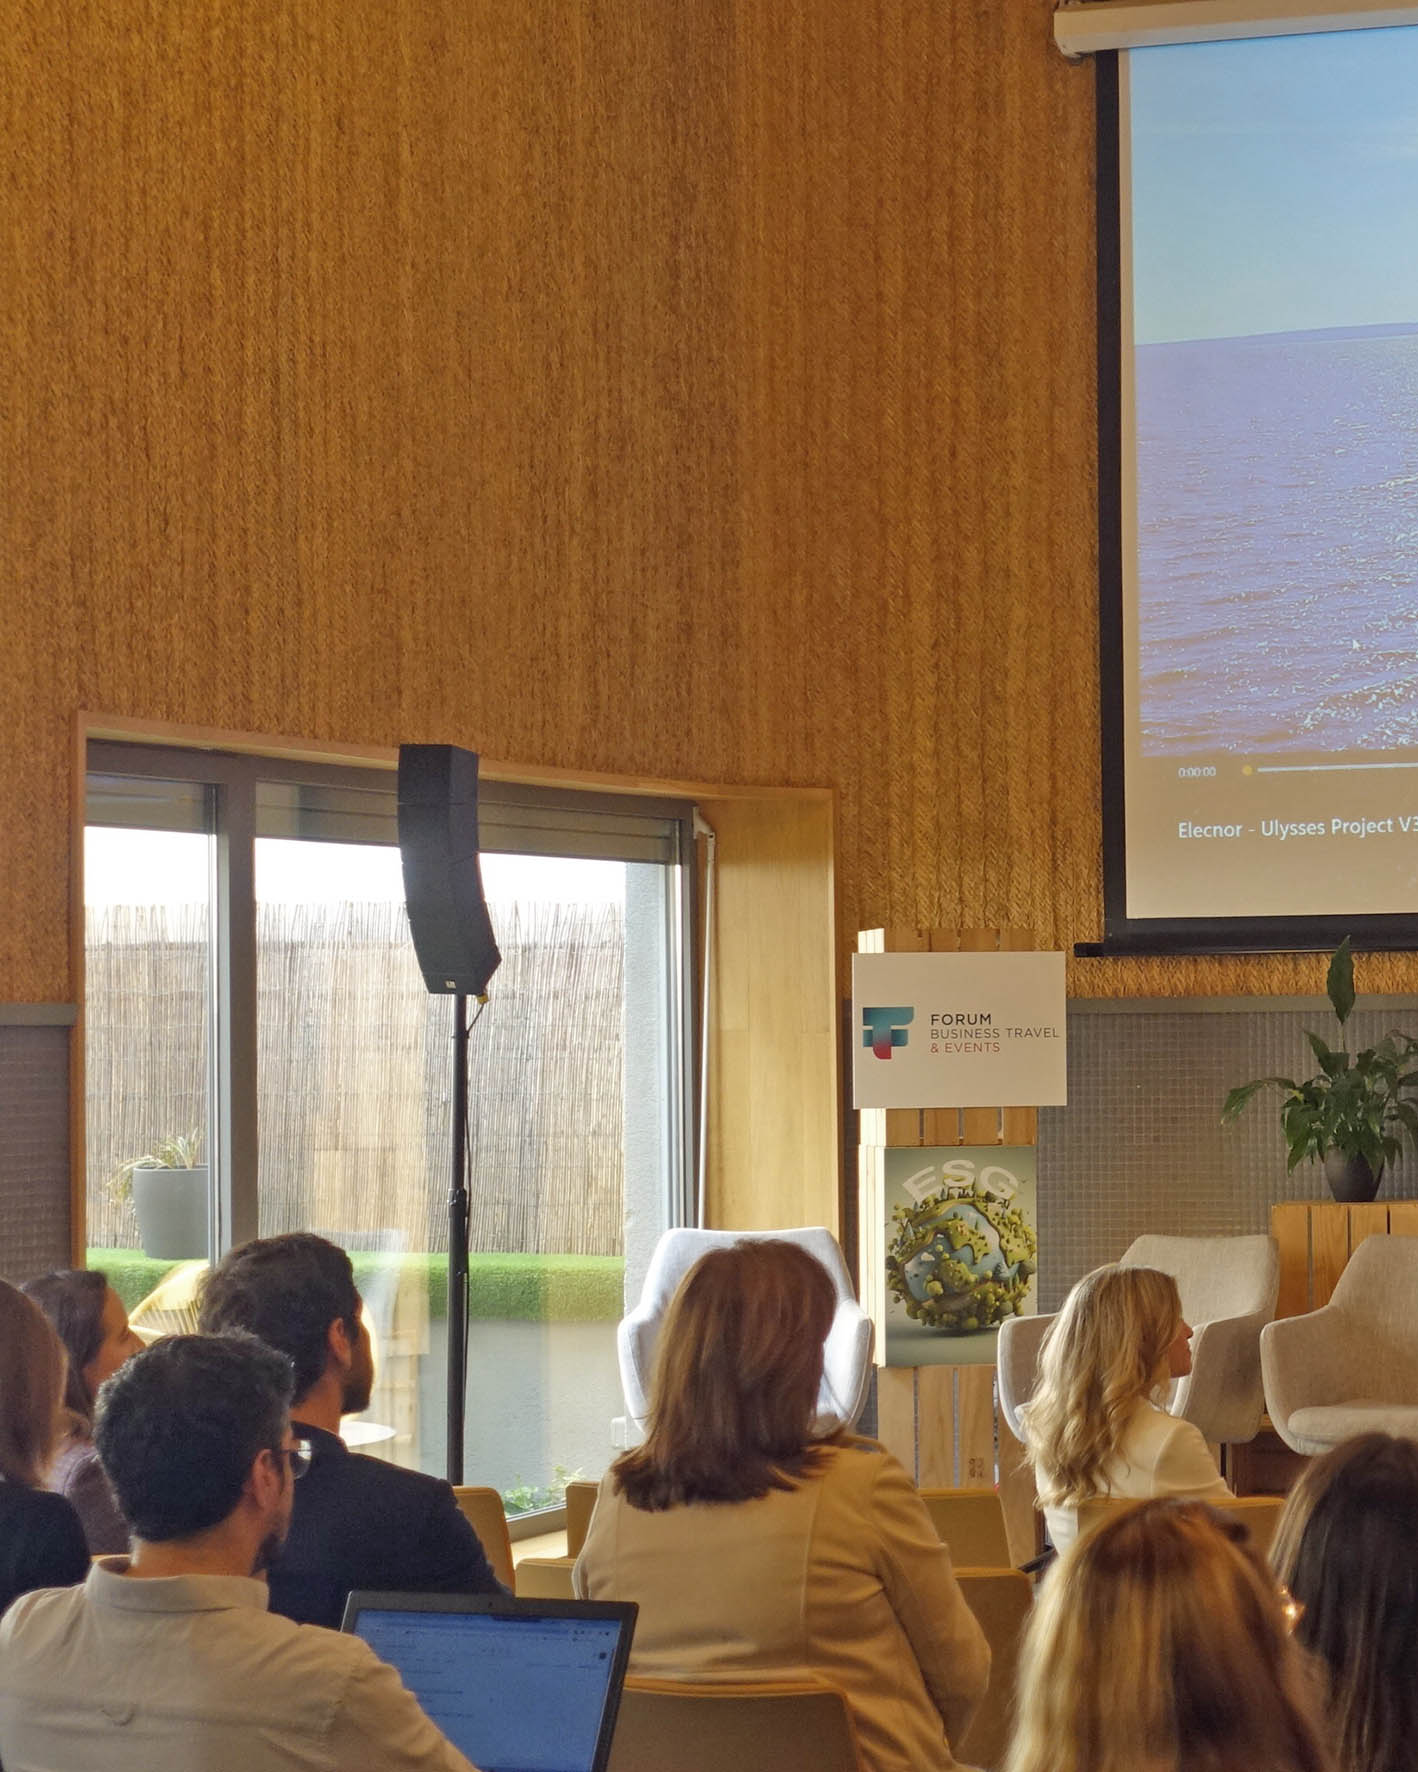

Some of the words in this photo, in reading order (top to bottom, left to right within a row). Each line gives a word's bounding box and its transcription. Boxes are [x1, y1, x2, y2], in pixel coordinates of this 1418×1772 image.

[1178, 821, 1243, 839] Elecnor
[1261, 819, 1326, 841] Ulysses
[1331, 816, 1394, 839] Project
[930, 1013, 992, 1026] FORUM
[930, 1027, 1001, 1040] BUSINESS
[1006, 1027, 1060, 1039] TRAVEL
[930, 1042, 939, 1054] &
[944, 1042, 1001, 1054] EVENTS
[902, 1159, 1019, 1202] ESG
